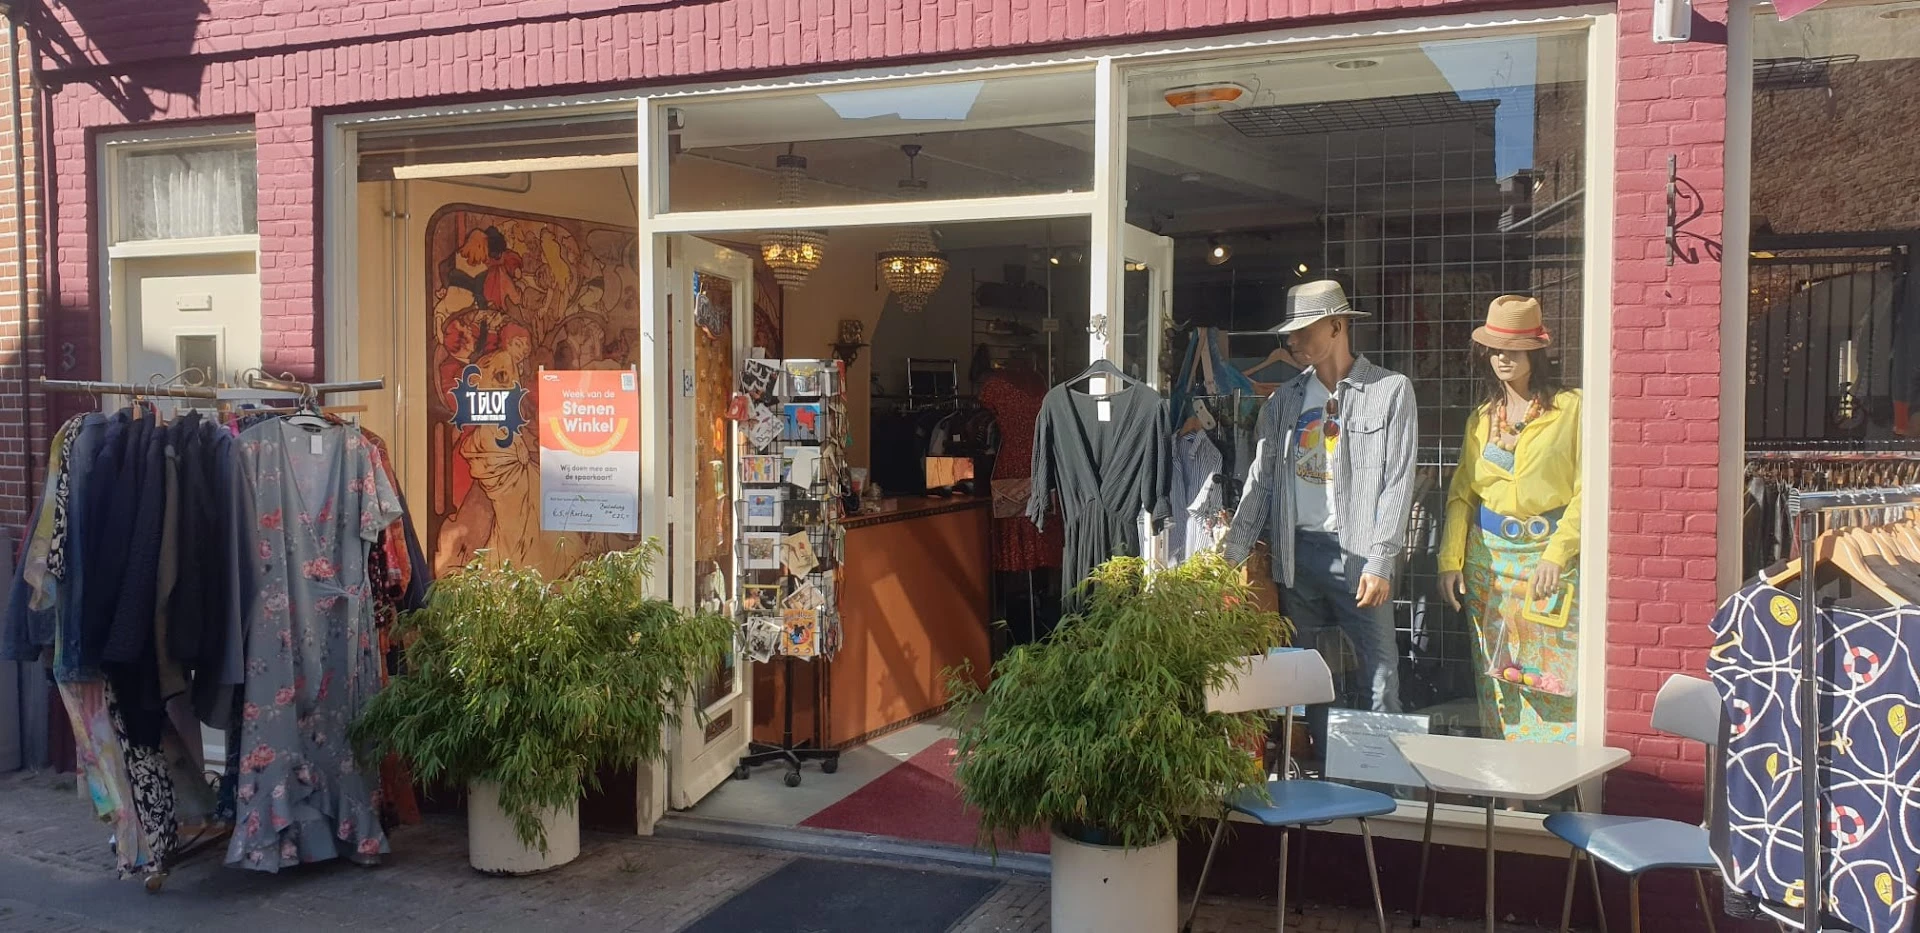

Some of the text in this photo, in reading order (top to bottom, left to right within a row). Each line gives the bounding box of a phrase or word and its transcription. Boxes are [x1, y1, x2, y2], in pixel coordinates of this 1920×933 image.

[562, 389, 585, 398] Week
[604, 389, 615, 398] de
[478, 391, 510, 414] GLOP
[562, 400, 615, 416] Stenen
[563, 417, 614, 433] Winkel
[560, 464, 571, 472] Wij
[572, 464, 588, 472] doen
